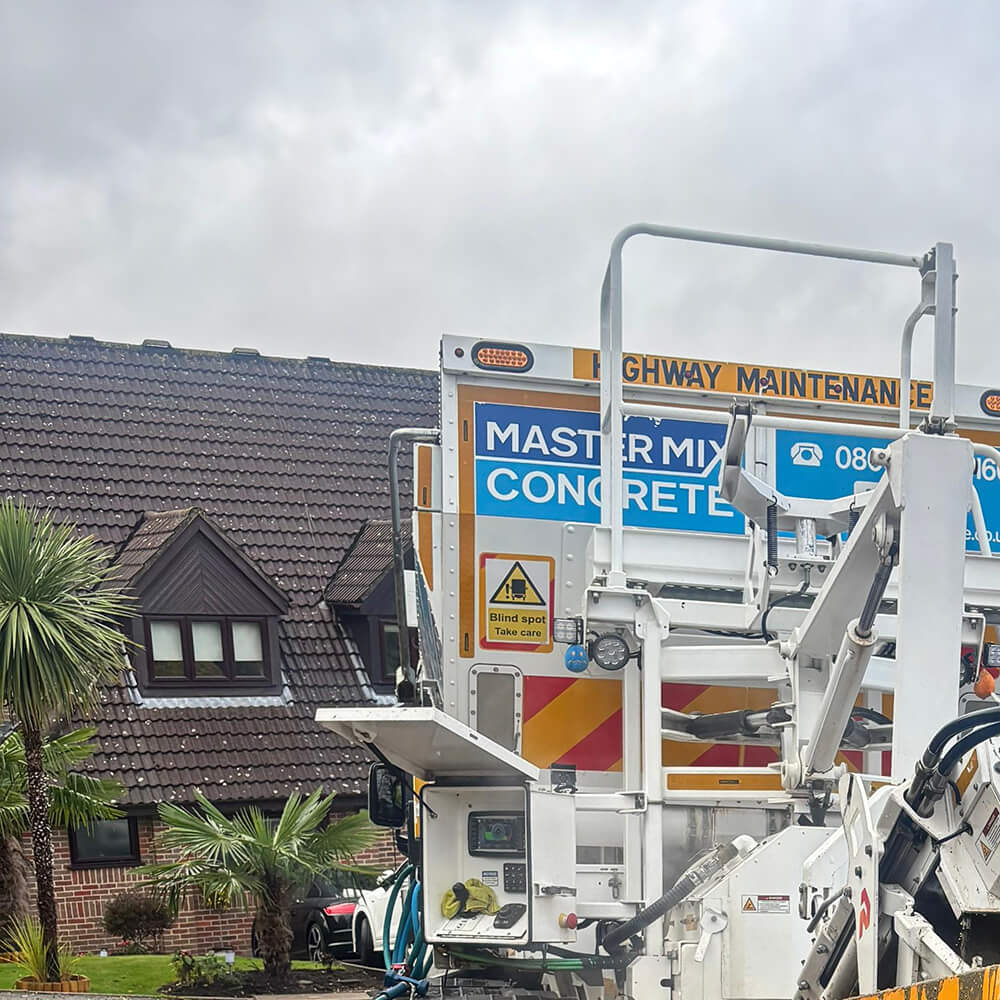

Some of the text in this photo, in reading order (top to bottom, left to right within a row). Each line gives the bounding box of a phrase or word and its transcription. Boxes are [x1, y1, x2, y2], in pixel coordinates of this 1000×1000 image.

[592, 352, 933, 409] HGHWAY MAINTENANE
[486, 420, 728, 468] MASTR MIX
[489, 612, 546, 625] Blind spot
[495, 627, 542, 638] Take care
